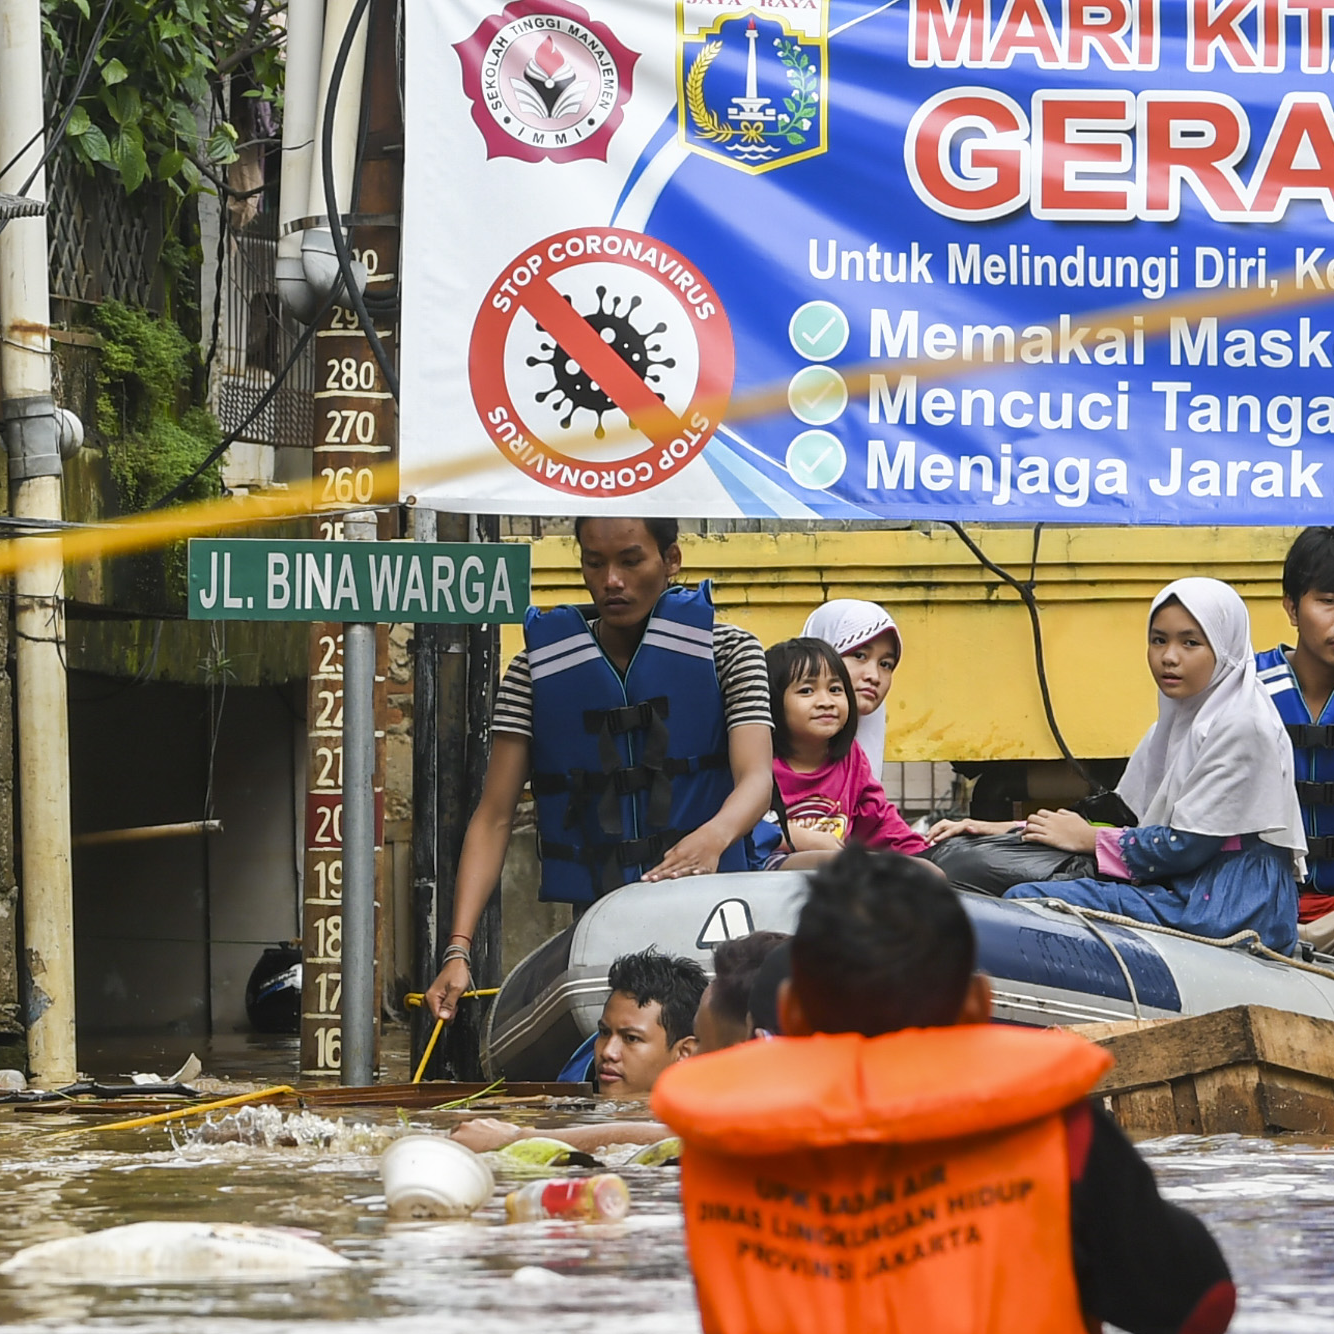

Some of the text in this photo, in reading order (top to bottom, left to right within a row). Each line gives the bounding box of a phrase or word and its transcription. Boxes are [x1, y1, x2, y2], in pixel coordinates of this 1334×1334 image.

[485, 17, 615, 111] SEKOLAH TINGGI MANAJEMEN
[908, 0, 1160, 70] MARI
[492, 234, 716, 320] STOP CORONAVIRUS
[808, 238, 934, 284] Untuk
[947, 241, 1180, 300] Melindungi
[1194, 246, 1280, 297] Diri,
[869, 307, 1146, 366] Memakai
[325, 357, 375, 391] 280
[867, 373, 1130, 431] Mencuci
[324, 409, 375, 444] 270
[487, 406, 710, 490] STOP CORONAVIRUS
[320, 466, 374, 504] 260
[866, 438, 1129, 508] Menjaga
[1148, 447, 1324, 499] Jarak
[198, 551, 515, 614] JL. BINA WARGA
[771, 1203, 936, 1248] LINGKUNGAN
[947, 1178, 1034, 1215] HIDUP
[865, 1223, 981, 1279] JAKARTA
